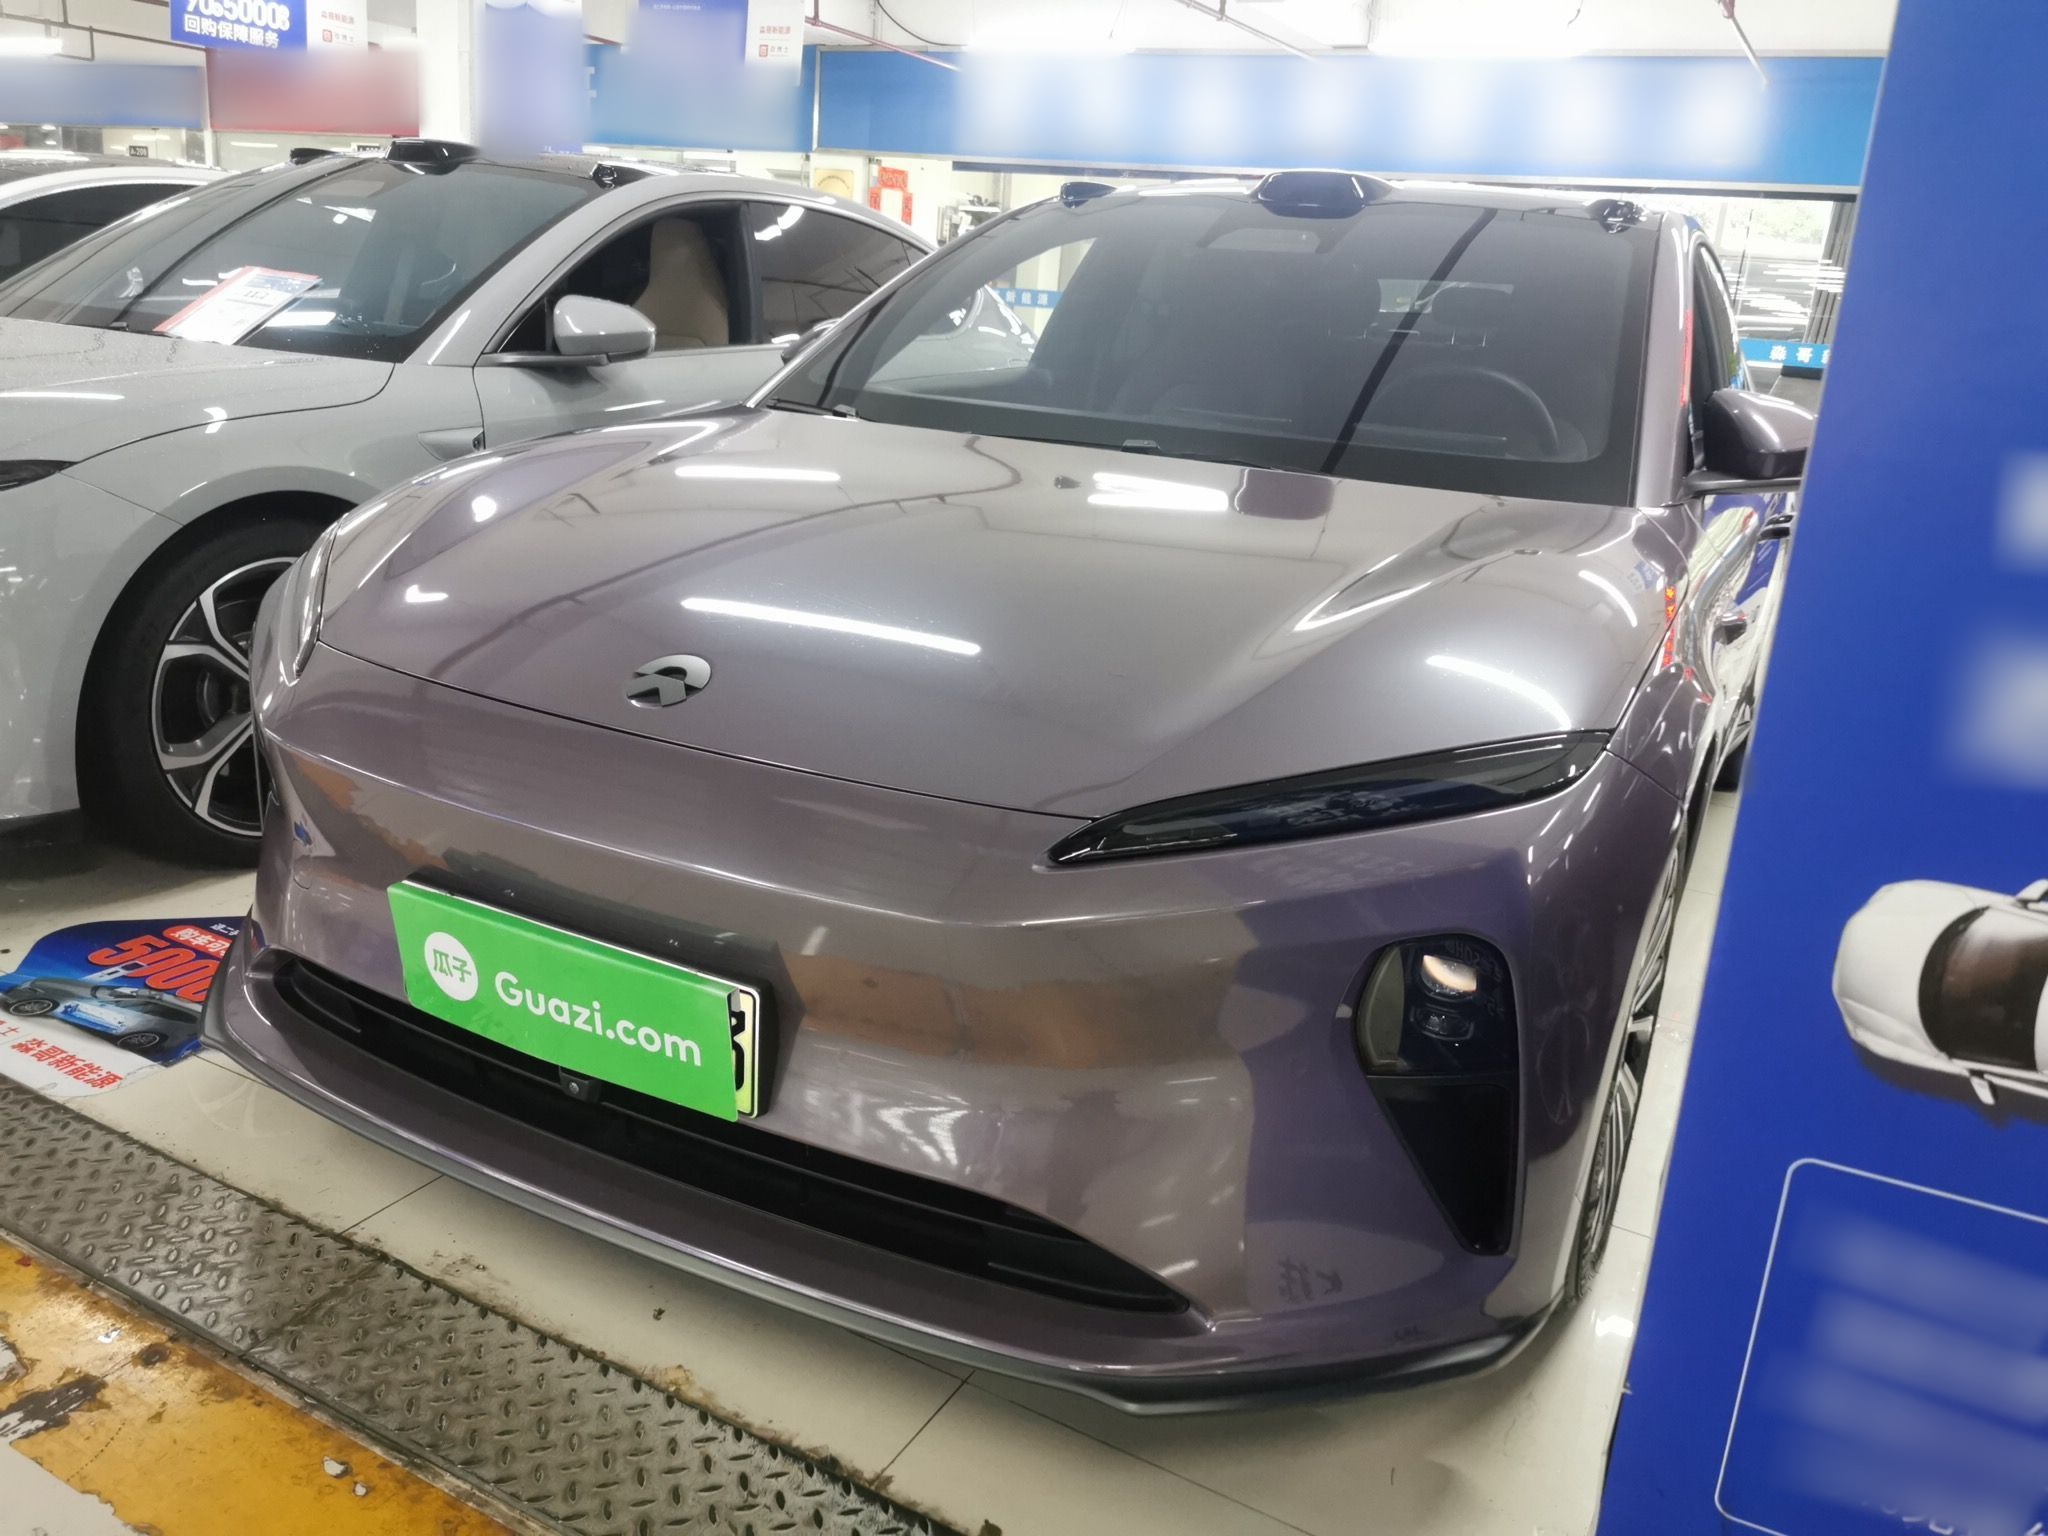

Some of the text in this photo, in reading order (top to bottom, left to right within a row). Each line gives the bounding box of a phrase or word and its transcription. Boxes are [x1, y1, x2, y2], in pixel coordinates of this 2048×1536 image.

[184, 14, 279, 48] 回购保障服务
[994, 289, 1048, 306] 新能源
[170, 927, 231, 957] 购车可
[431, 948, 473, 984] 瓜子
[495, 971, 702, 1067] Guazi.com
